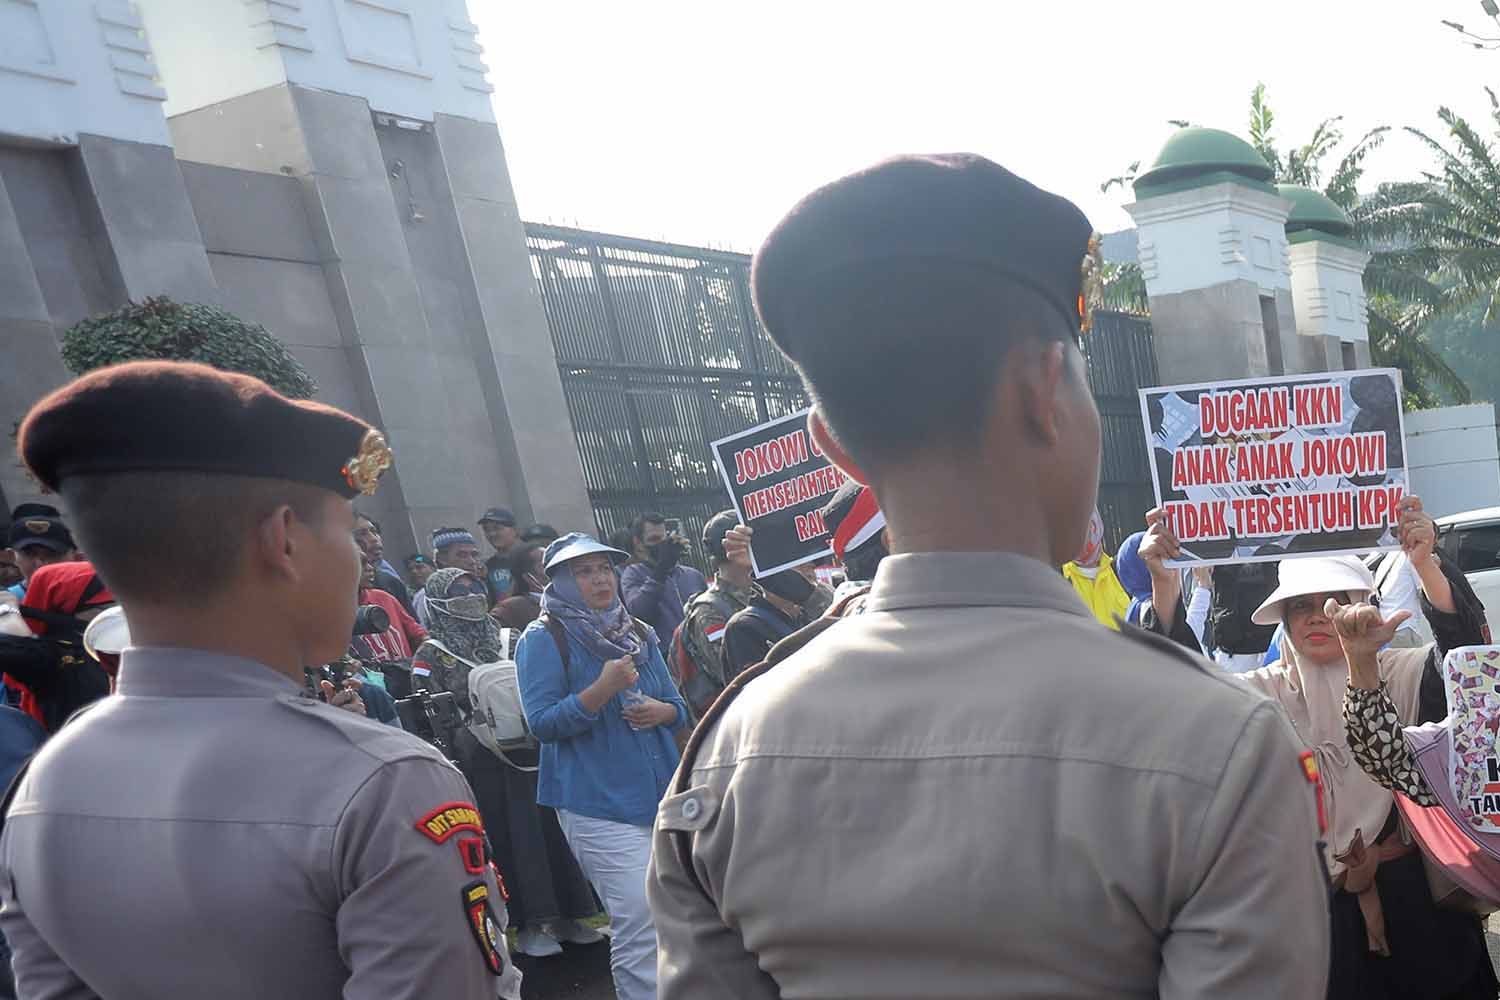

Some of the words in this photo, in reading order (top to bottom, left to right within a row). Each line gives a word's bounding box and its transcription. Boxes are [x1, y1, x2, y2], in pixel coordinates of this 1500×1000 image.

[1200, 388, 1289, 435] DUGAAN
[1294, 384, 1343, 426] KKN
[734, 430, 809, 485] JOKOWI
[1172, 446, 1231, 488] ANAK
[1235, 441, 1296, 482] ANAK
[1300, 434, 1386, 478] JOKOWI
[1165, 501, 1227, 540] TIDAK
[1231, 491, 1350, 537] TERSENTUH
[1358, 486, 1404, 527] KPK
